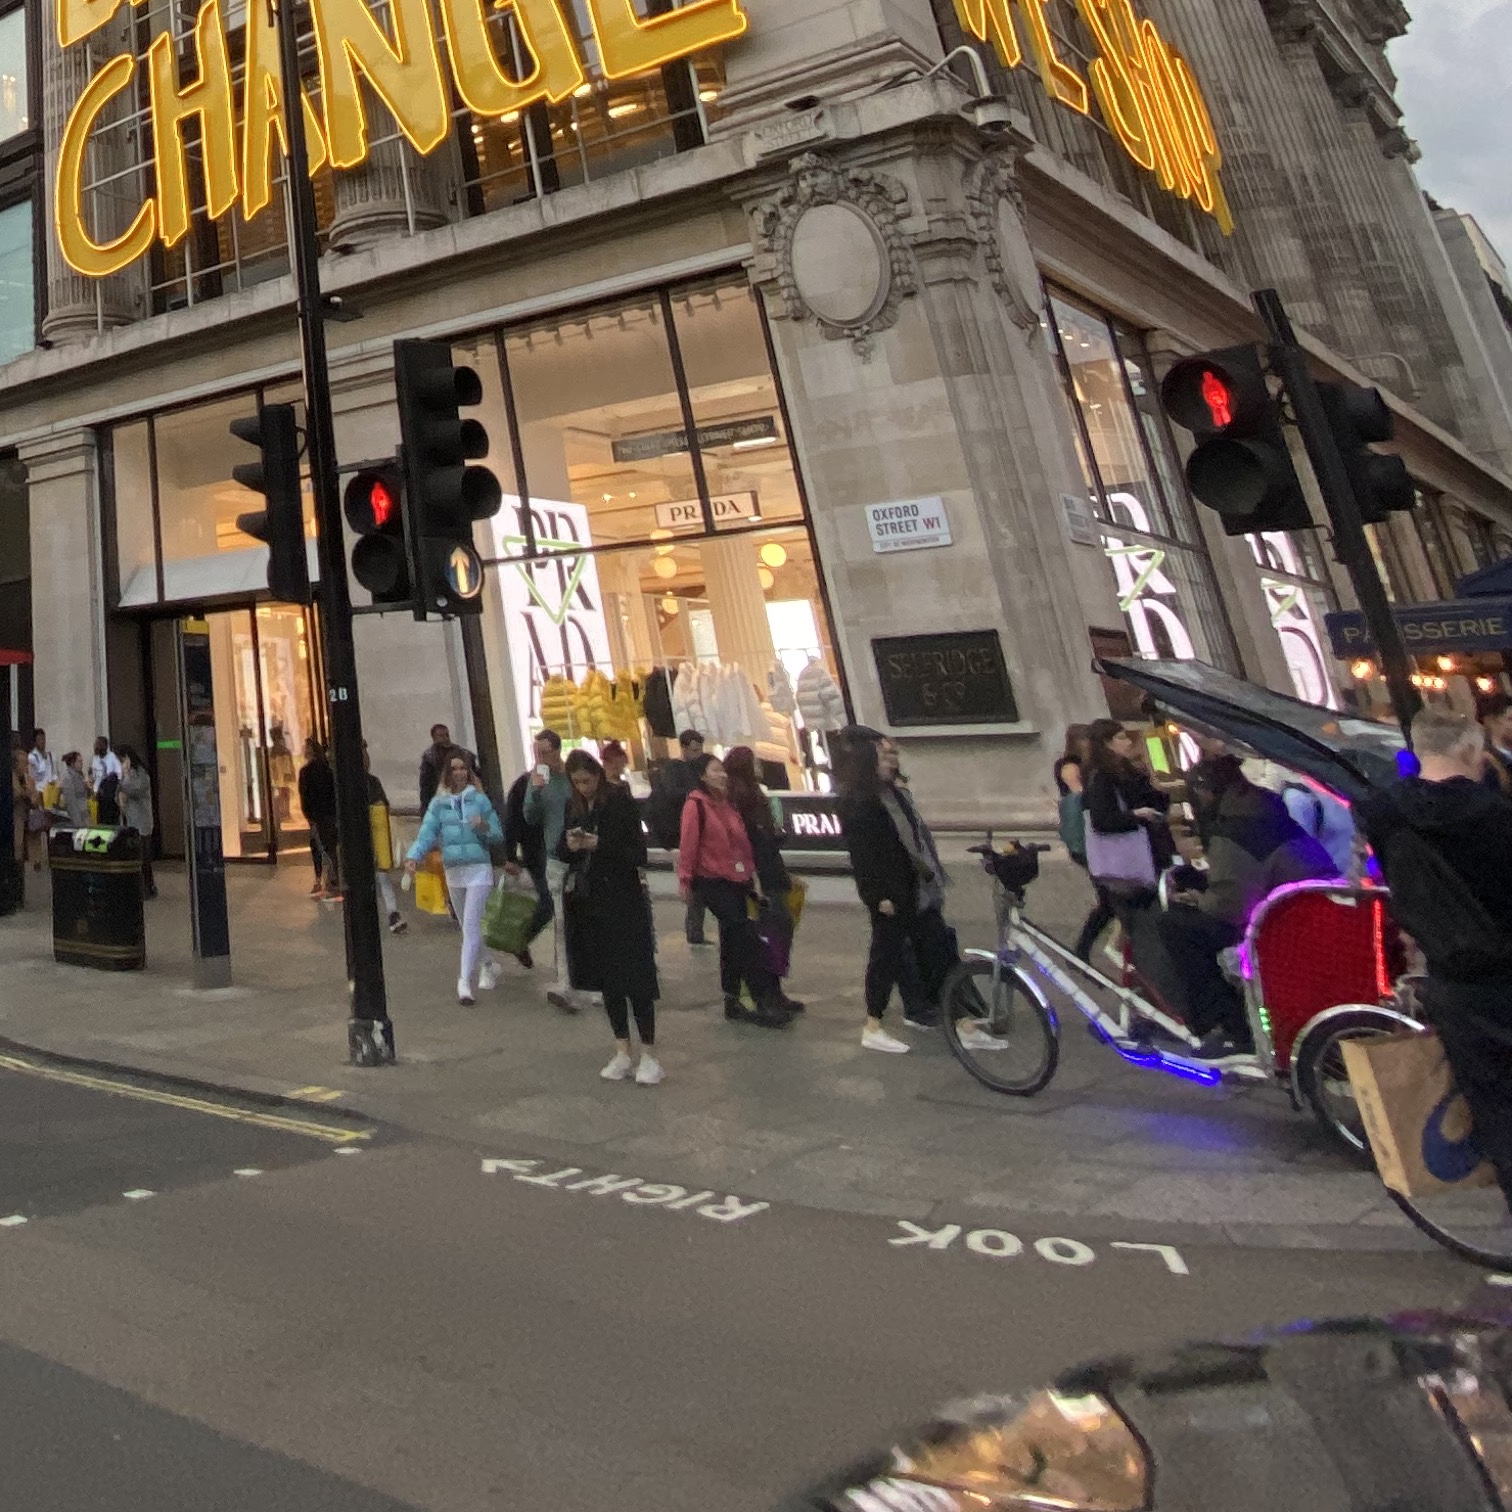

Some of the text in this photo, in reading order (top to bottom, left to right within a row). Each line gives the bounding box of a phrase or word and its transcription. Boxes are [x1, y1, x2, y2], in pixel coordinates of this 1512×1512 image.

[669, 499, 741, 522] PRDA
[872, 504, 919, 521] OXFORD
[876, 517, 942, 536] STREET W1
[1343, 617, 1508, 644] PSSERIE
[512, 1167, 1190, 1275] LOOK RIGHT
